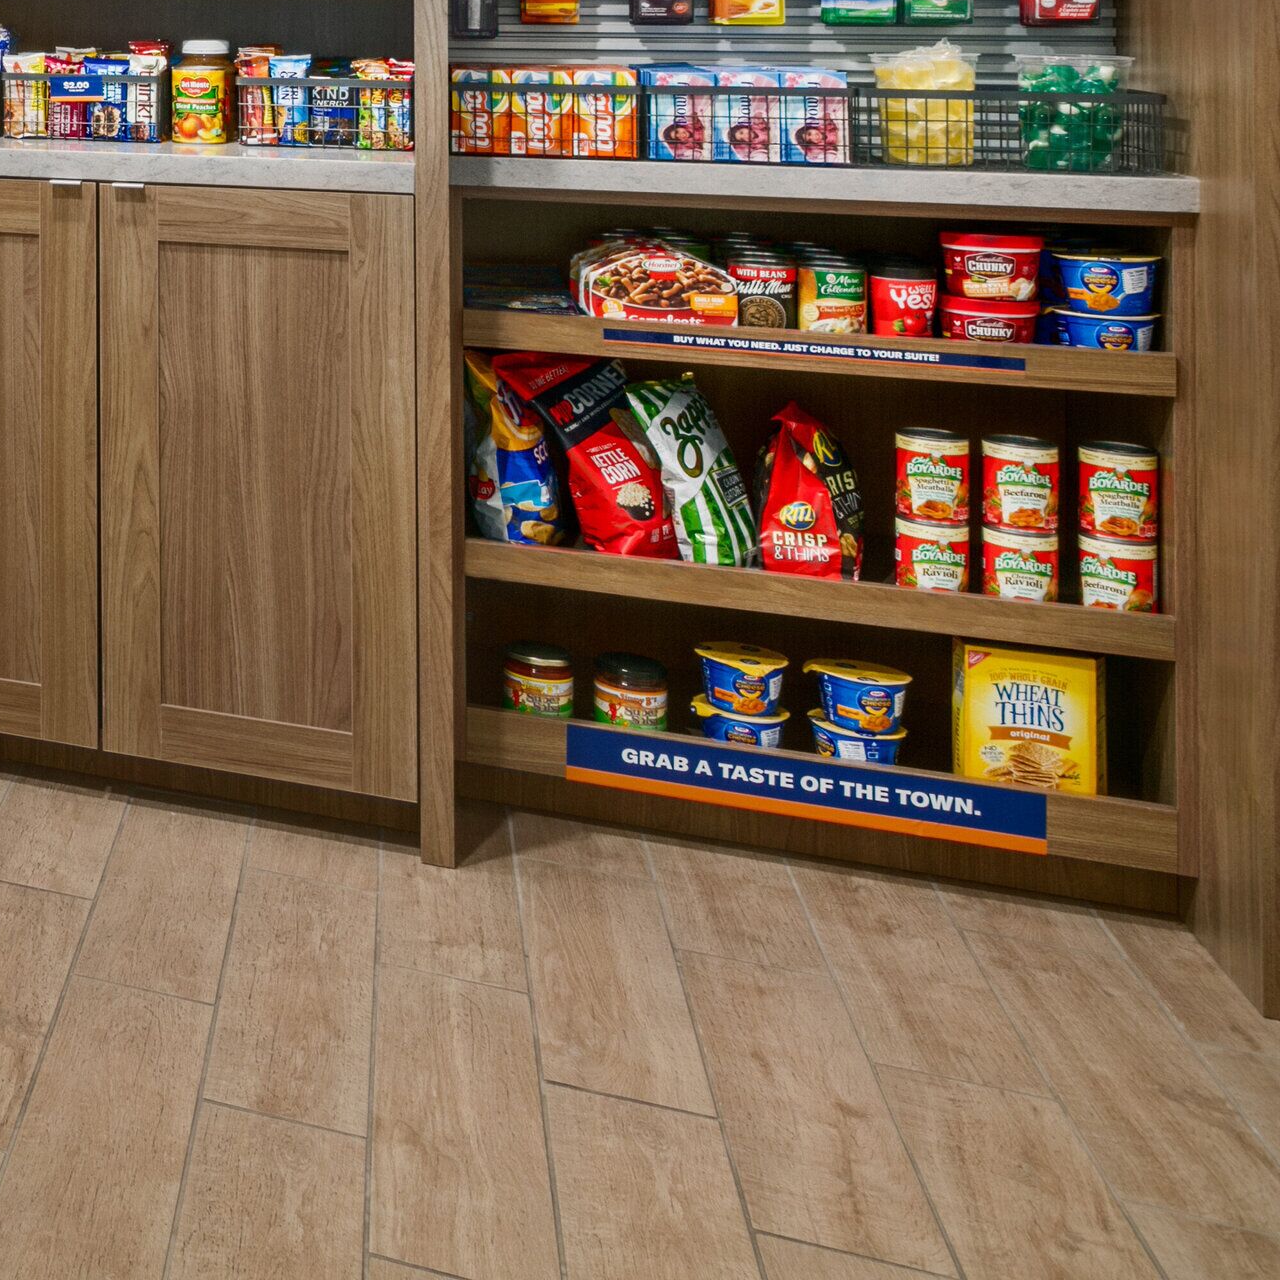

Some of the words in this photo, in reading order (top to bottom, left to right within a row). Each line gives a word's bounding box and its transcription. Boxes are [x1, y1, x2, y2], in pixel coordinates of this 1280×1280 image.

[63, 81, 89, 89] $2.00
[647, 260, 679, 270] Hormel
[968, 262, 1013, 273] CHUNKY
[736, 268, 758, 278] WITH
[760, 269, 787, 279] BEANS
[890, 285, 936, 309] Yes!
[968, 327, 1013, 338] CHUNKY
[673, 335, 694, 344] BUY
[695, 337, 726, 346] WHAT
[728, 338, 750, 348] YOU
[750, 341, 781, 351] NEED.
[783, 342, 808, 353] JUST
[809, 344, 855, 356] CHARGE
[856, 348, 871, 357] TO
[872, 349, 903, 360] YOUR
[904, 351, 940, 362] SUITE!
[590, 447, 629, 468] KETTLE
[600, 460, 641, 485] CORN
[906, 463, 962, 479] BOYARDEE
[996, 471, 1052, 487] BOYARDEE
[917, 483, 954, 493] Meatballs
[1089, 477, 1149, 495] BOYARDEE
[1003, 489, 1047, 500] Beefaroni
[1100, 499, 1140, 509] Meatballs
[780, 503, 815, 524] RITZ
[772, 531, 828, 548] CRISP
[912, 550, 966, 565] BOYARDEE
[922, 567, 958, 579] Ravioli
[995, 558, 1053, 574] BOYARDEE
[1081, 563, 1136, 583] BOYARDEE
[1005, 576, 1043, 589] Ravioli
[1084, 581, 1127, 596] Beefaroni
[1009, 672, 1038, 685] WHOLE
[1040, 676, 1068, 689] GRAIN
[992, 682, 1065, 708] WHEAT
[1009, 729, 1051, 742] original
[621, 748, 689, 772] GRAB
[695, 760, 712, 776] A
[718, 762, 794, 789] TASTE
[801, 775, 834, 793] OF
[839, 780, 889, 802] THE
[895, 788, 982, 816] TOWN.
